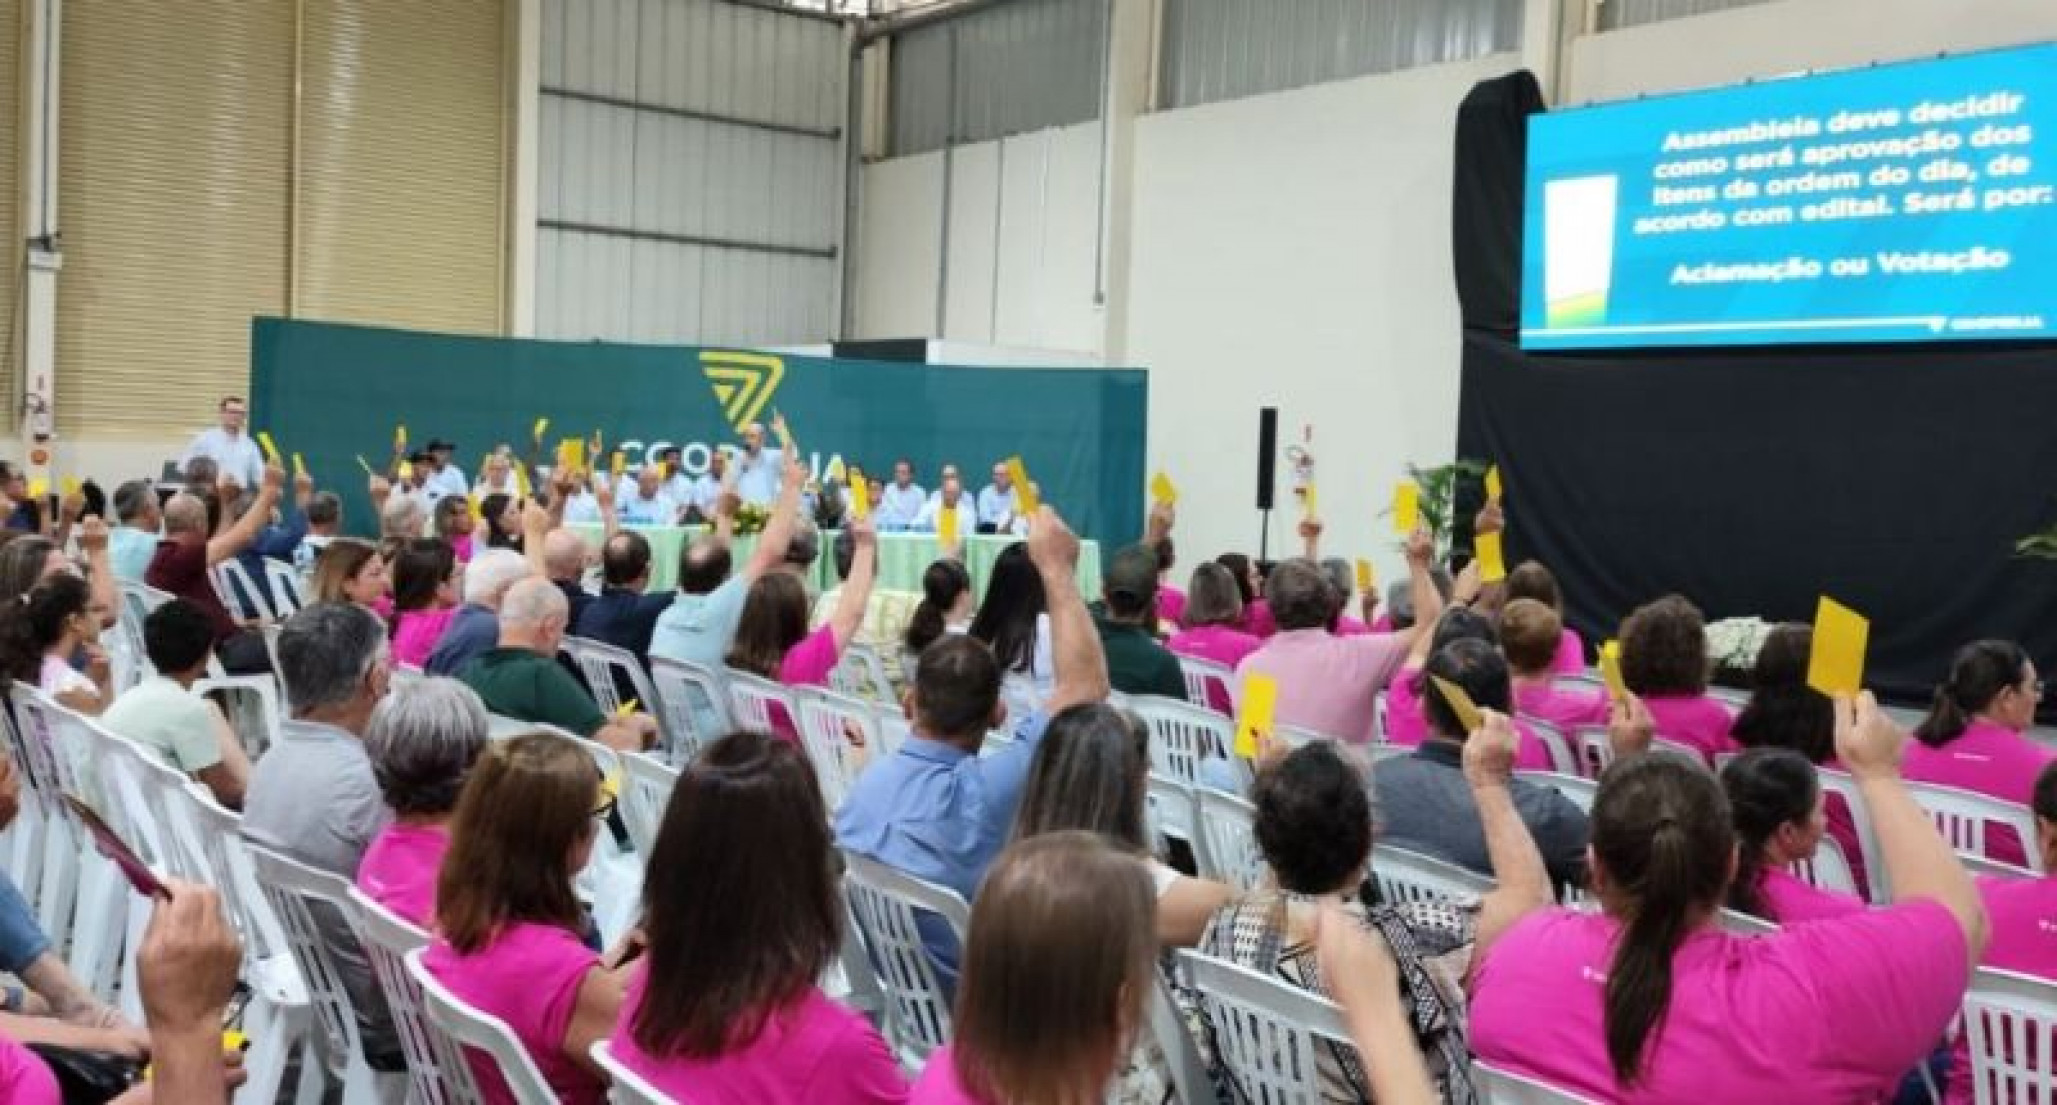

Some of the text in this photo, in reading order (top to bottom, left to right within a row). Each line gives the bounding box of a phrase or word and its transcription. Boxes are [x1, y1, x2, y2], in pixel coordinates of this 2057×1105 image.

[1826, 110, 1901, 133] deve
[1908, 92, 2023, 123] decidir
[1654, 124, 2031, 179] como será aprovação dos
[1723, 179, 1759, 198] da
[1764, 172, 1861, 196] ordem
[1869, 164, 1911, 185] do
[1918, 157, 1977, 182] dia,
[1987, 154, 2031, 177] de
[1635, 185, 2052, 234] acordo com edital. Será por:
[1672, 247, 2008, 283] Aclamação ou Votação
